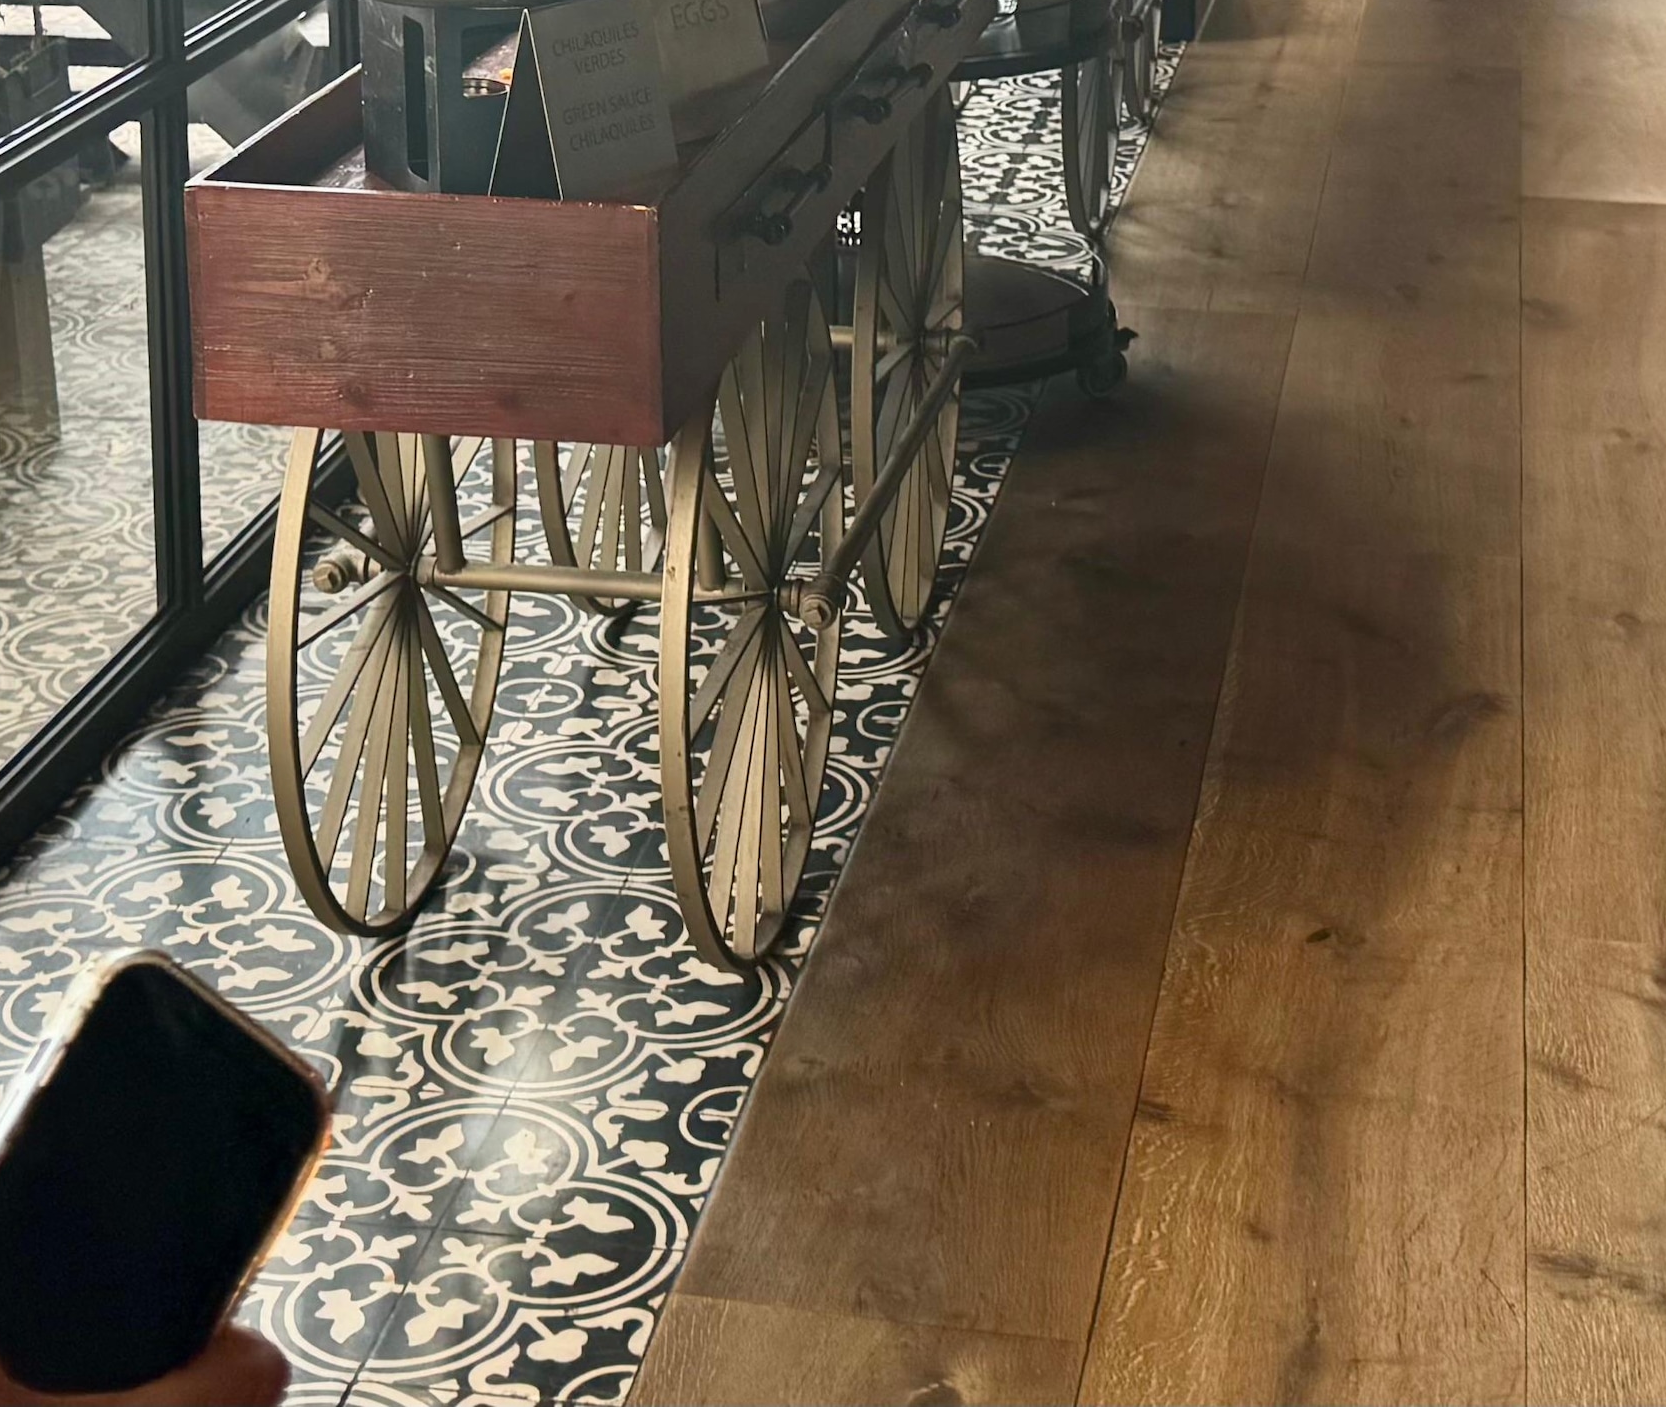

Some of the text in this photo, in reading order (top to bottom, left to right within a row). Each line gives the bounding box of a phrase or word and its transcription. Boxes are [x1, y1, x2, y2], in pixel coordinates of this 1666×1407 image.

[552, 20, 639, 57] CHILAQUILES
[574, 48, 627, 74] VERDES
[562, 86, 653, 126] GREEN SAUCE
[569, 113, 655, 151] CHILAQUILES
